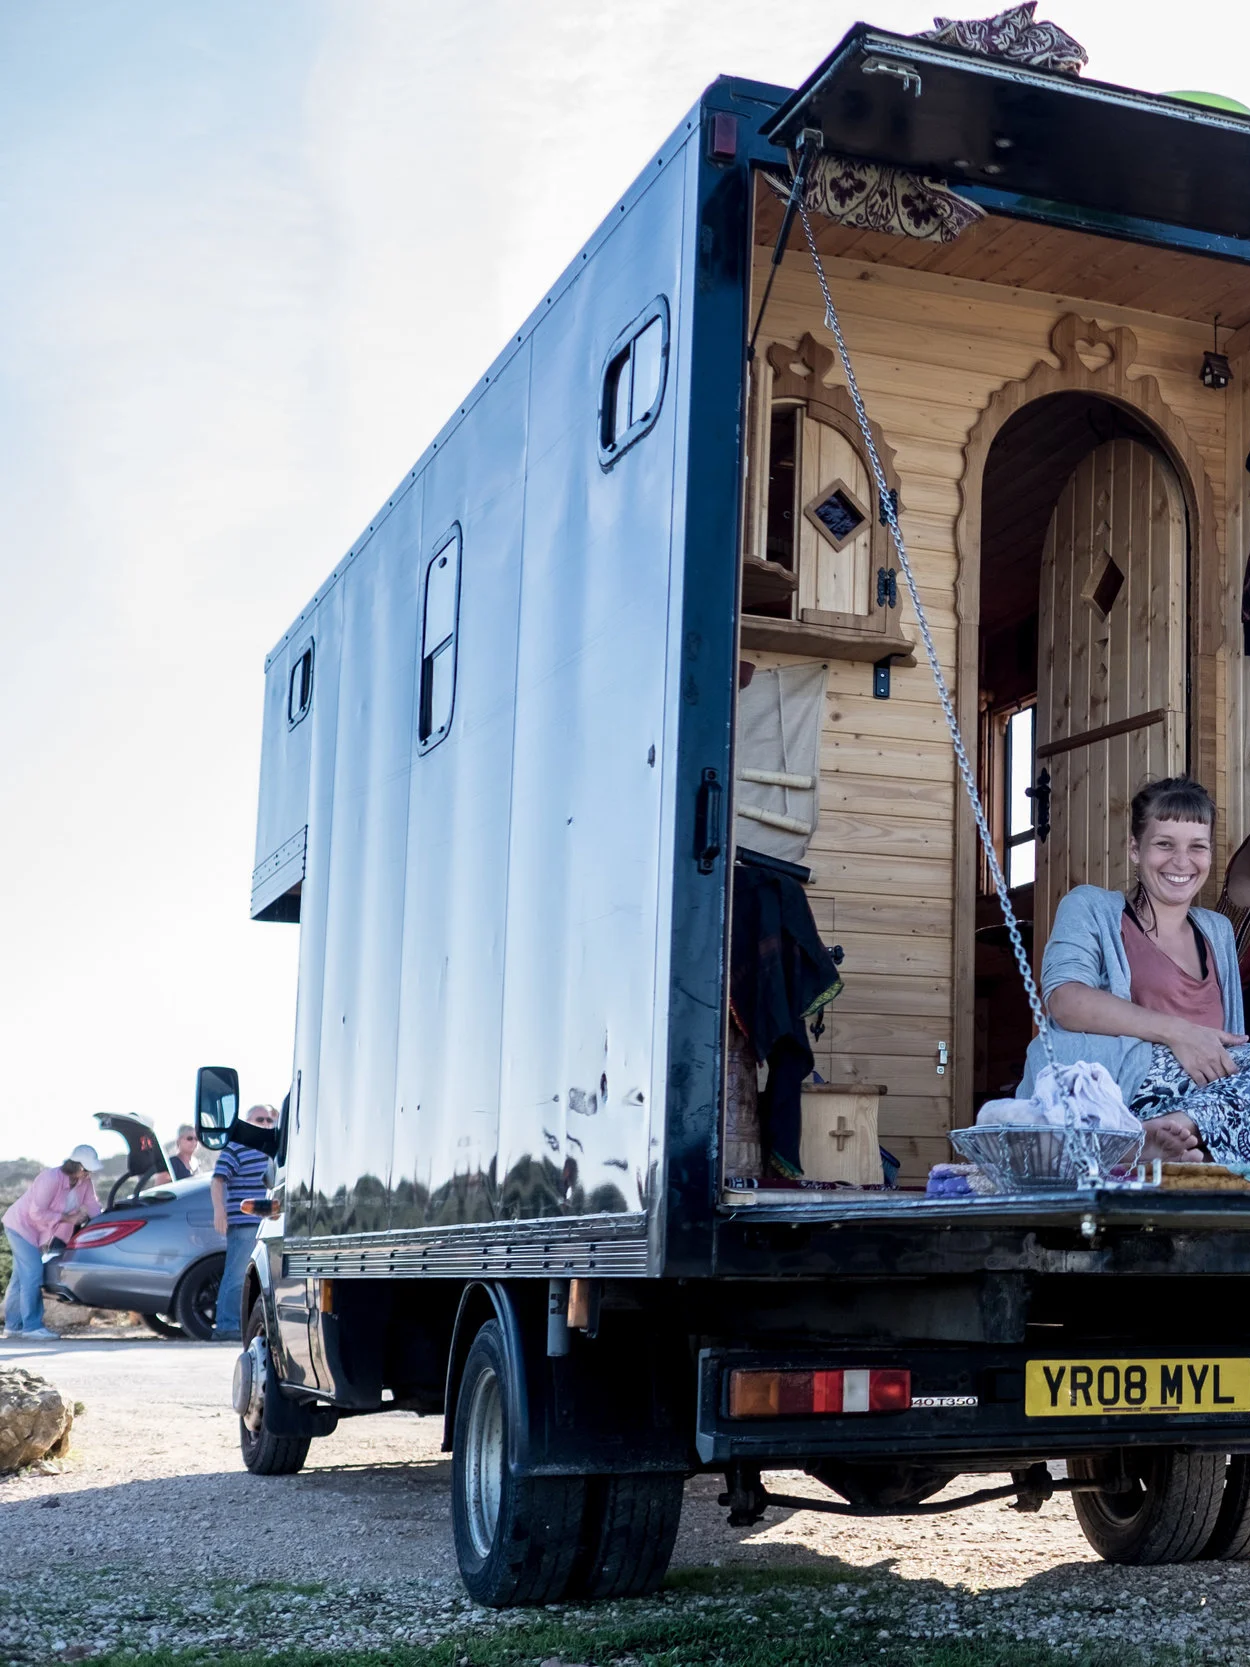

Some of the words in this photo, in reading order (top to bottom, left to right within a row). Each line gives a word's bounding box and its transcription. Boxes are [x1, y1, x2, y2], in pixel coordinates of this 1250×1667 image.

[1043, 1365, 1147, 1407] YR08
[1160, 1364, 1235, 1405] MYL
[911, 1398, 934, 1406] 40
[936, 1397, 976, 1406] T350
